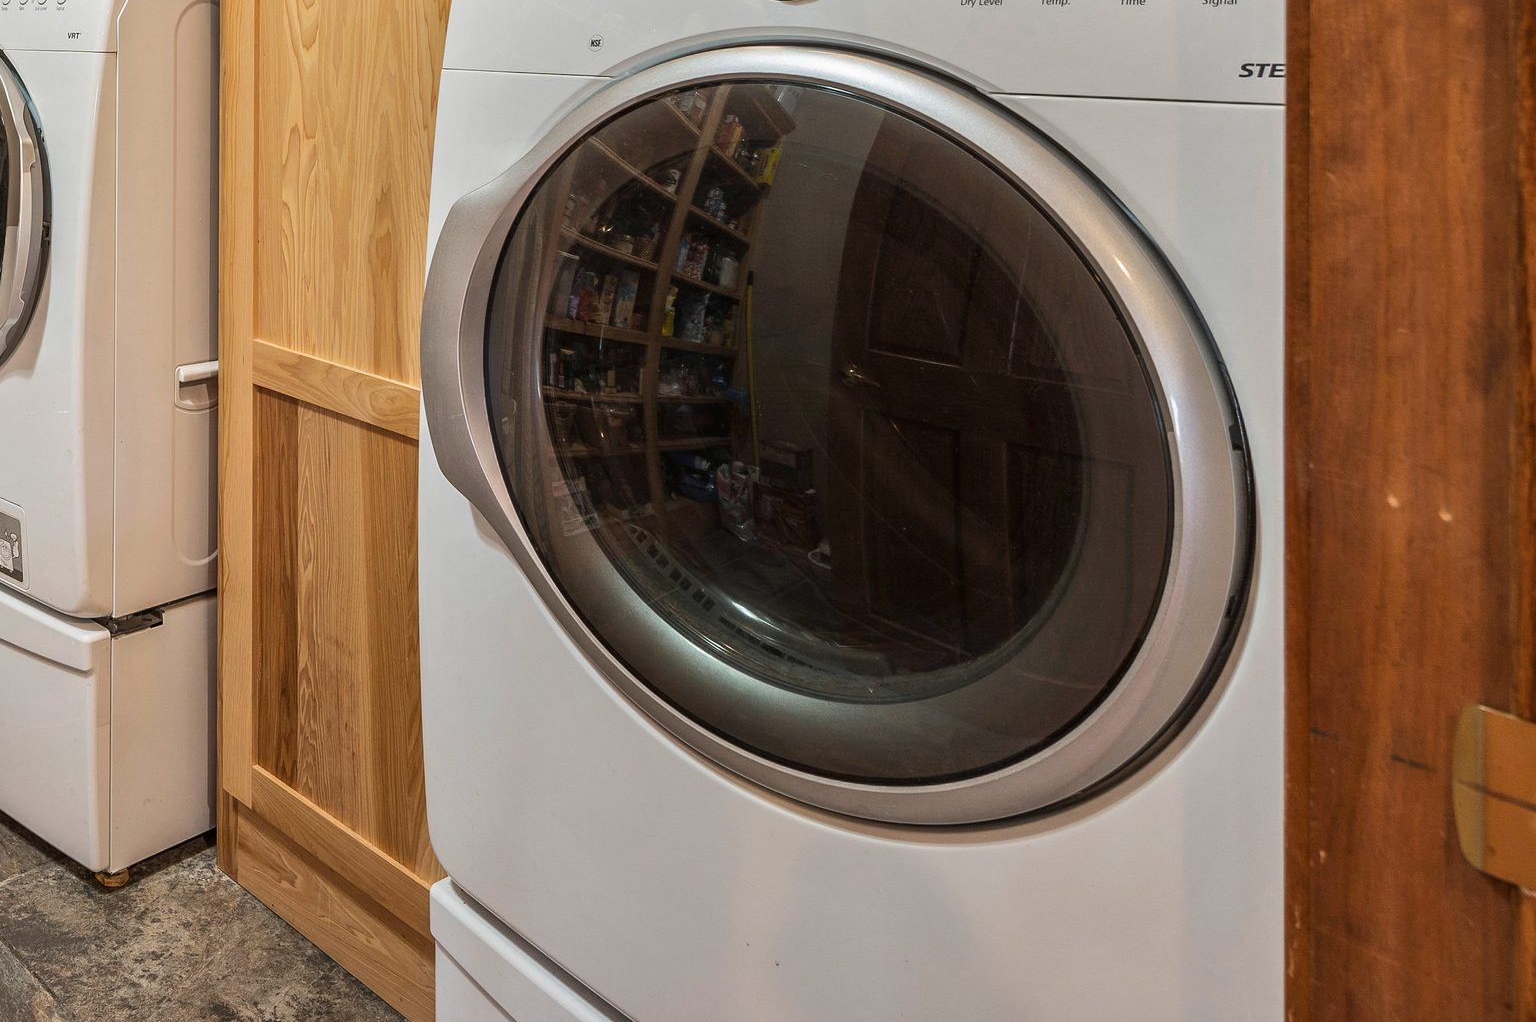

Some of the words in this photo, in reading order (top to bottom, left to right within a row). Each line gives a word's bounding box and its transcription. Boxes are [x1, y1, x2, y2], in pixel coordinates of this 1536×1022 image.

[67, 32, 81, 40] VRT
[590, 38, 602, 48] NSF
[1239, 63, 1286, 78] STE
